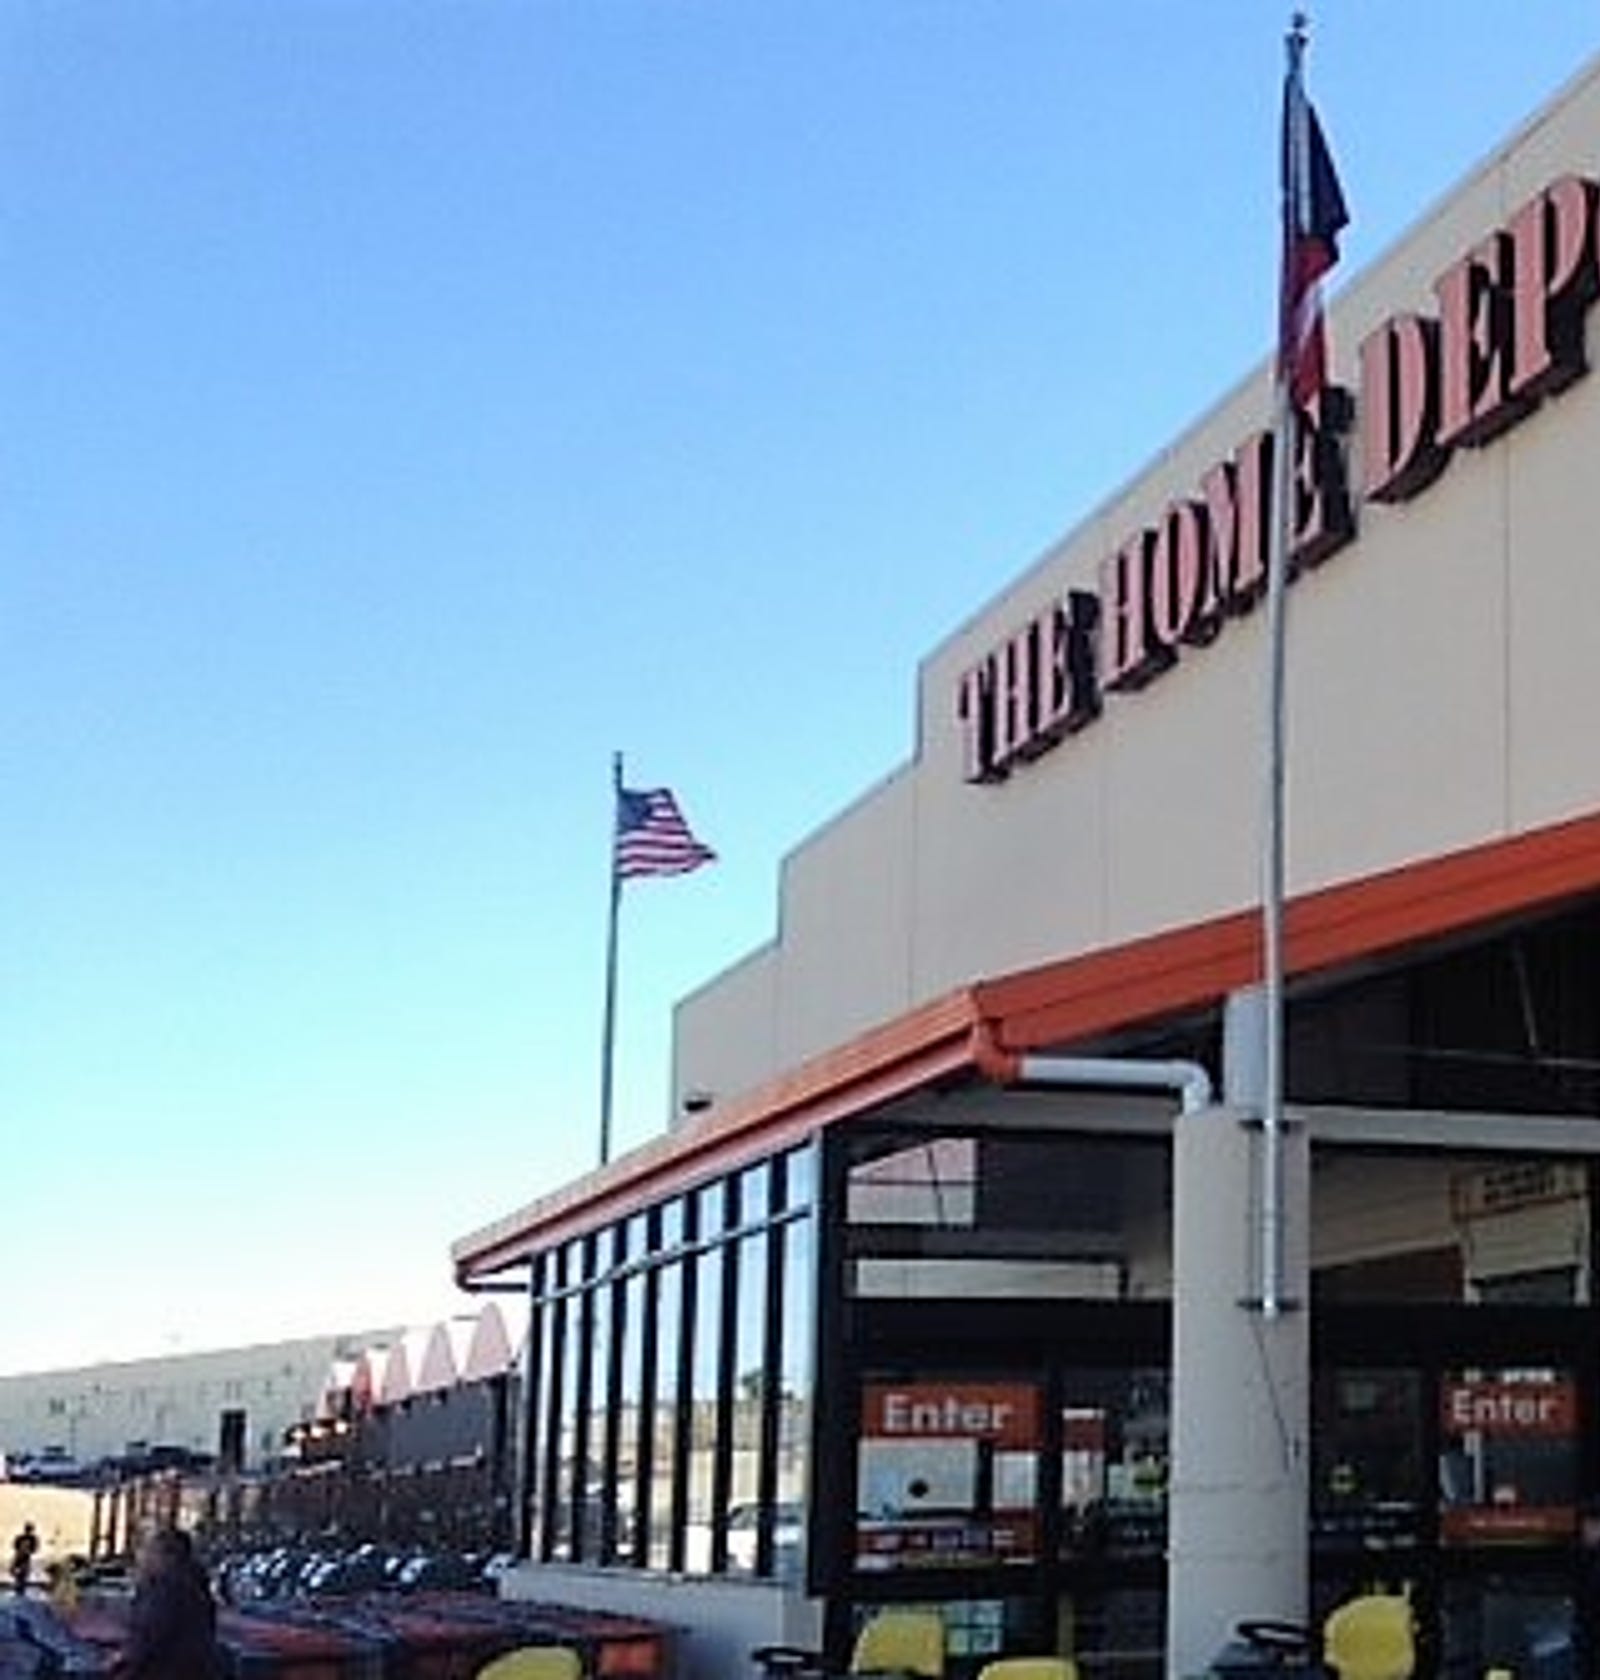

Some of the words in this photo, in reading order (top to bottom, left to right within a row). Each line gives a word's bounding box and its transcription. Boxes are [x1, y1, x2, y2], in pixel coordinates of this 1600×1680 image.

[957, 598, 1090, 783] THE
[884, 1394, 1013, 1432] Enter
[1453, 1390, 1557, 1424] Enter
